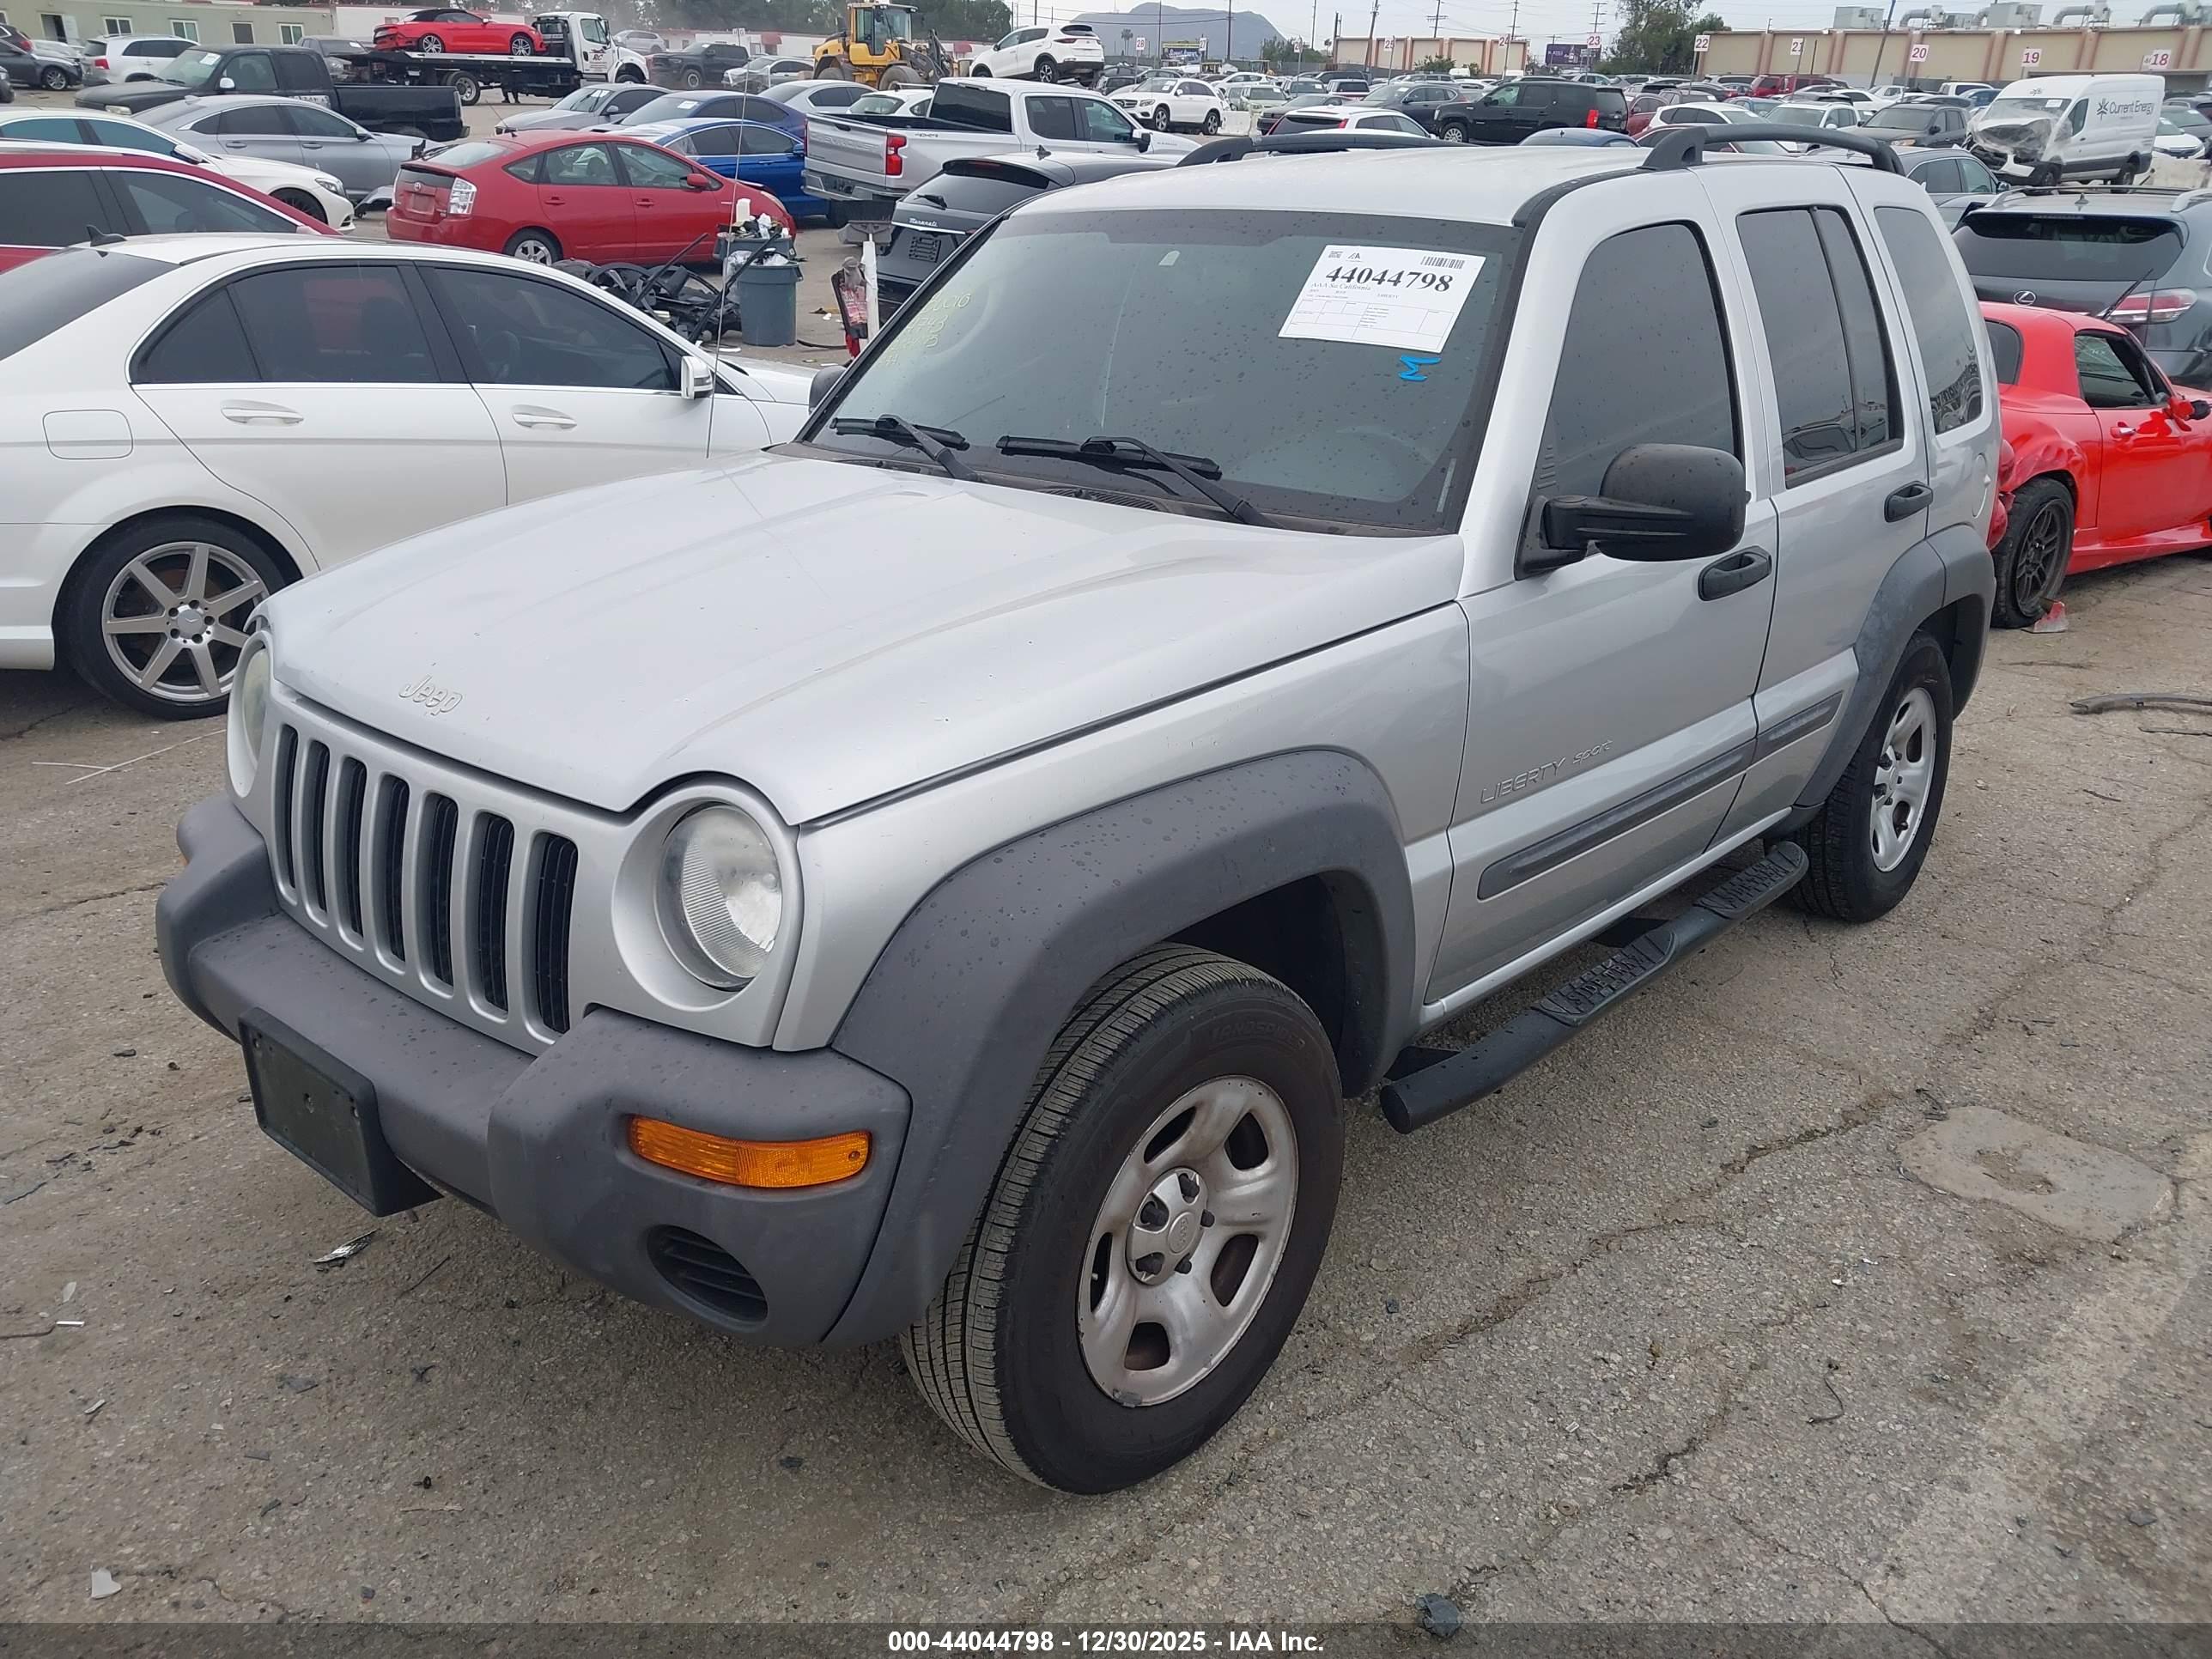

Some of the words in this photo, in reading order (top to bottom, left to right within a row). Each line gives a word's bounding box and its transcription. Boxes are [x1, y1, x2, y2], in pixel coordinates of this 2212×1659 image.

[1588, 35, 1601, 46] 23
[1695, 38, 1709, 49] 22
[1911, 47, 1927, 59] 20
[2022, 52, 2040, 64] 19
[2150, 53, 2169, 66] 18
[2109, 101, 2134, 114] Current
[2135, 100, 2154, 115] Energy
[1325, 265, 1453, 292] 44044798
[398, 674, 464, 716] Jeep
[1480, 757, 1566, 805] LIBERTY
